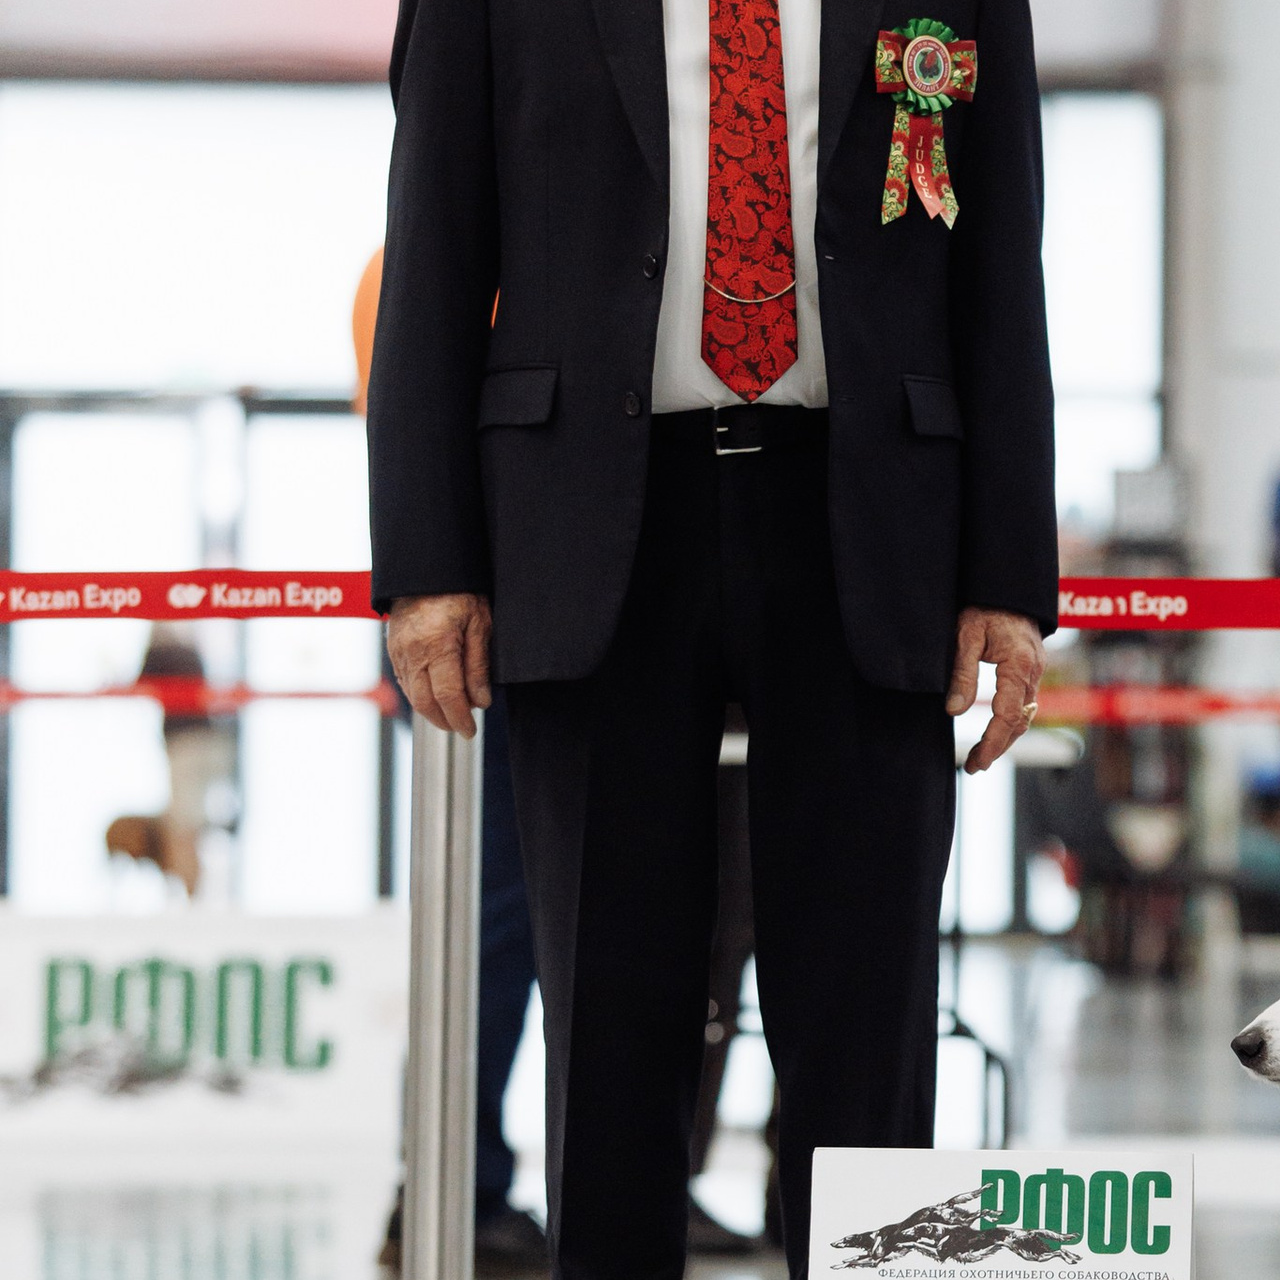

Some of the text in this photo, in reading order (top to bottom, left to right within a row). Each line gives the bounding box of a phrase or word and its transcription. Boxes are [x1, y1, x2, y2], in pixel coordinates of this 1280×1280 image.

[915, 135, 932, 199] JUDGE
[9, 583, 141, 613] Kazan Expo
[211, 581, 343, 613] Kazan Expo
[1130, 590, 1188, 622] Expo
[979, 1168, 1173, 1256] РФОС
[878, 1268, 956, 1280] ФЕДЕРАЦИЯ
[959, 1269, 1055, 1280] ОХОТНИЧЬЕГО
